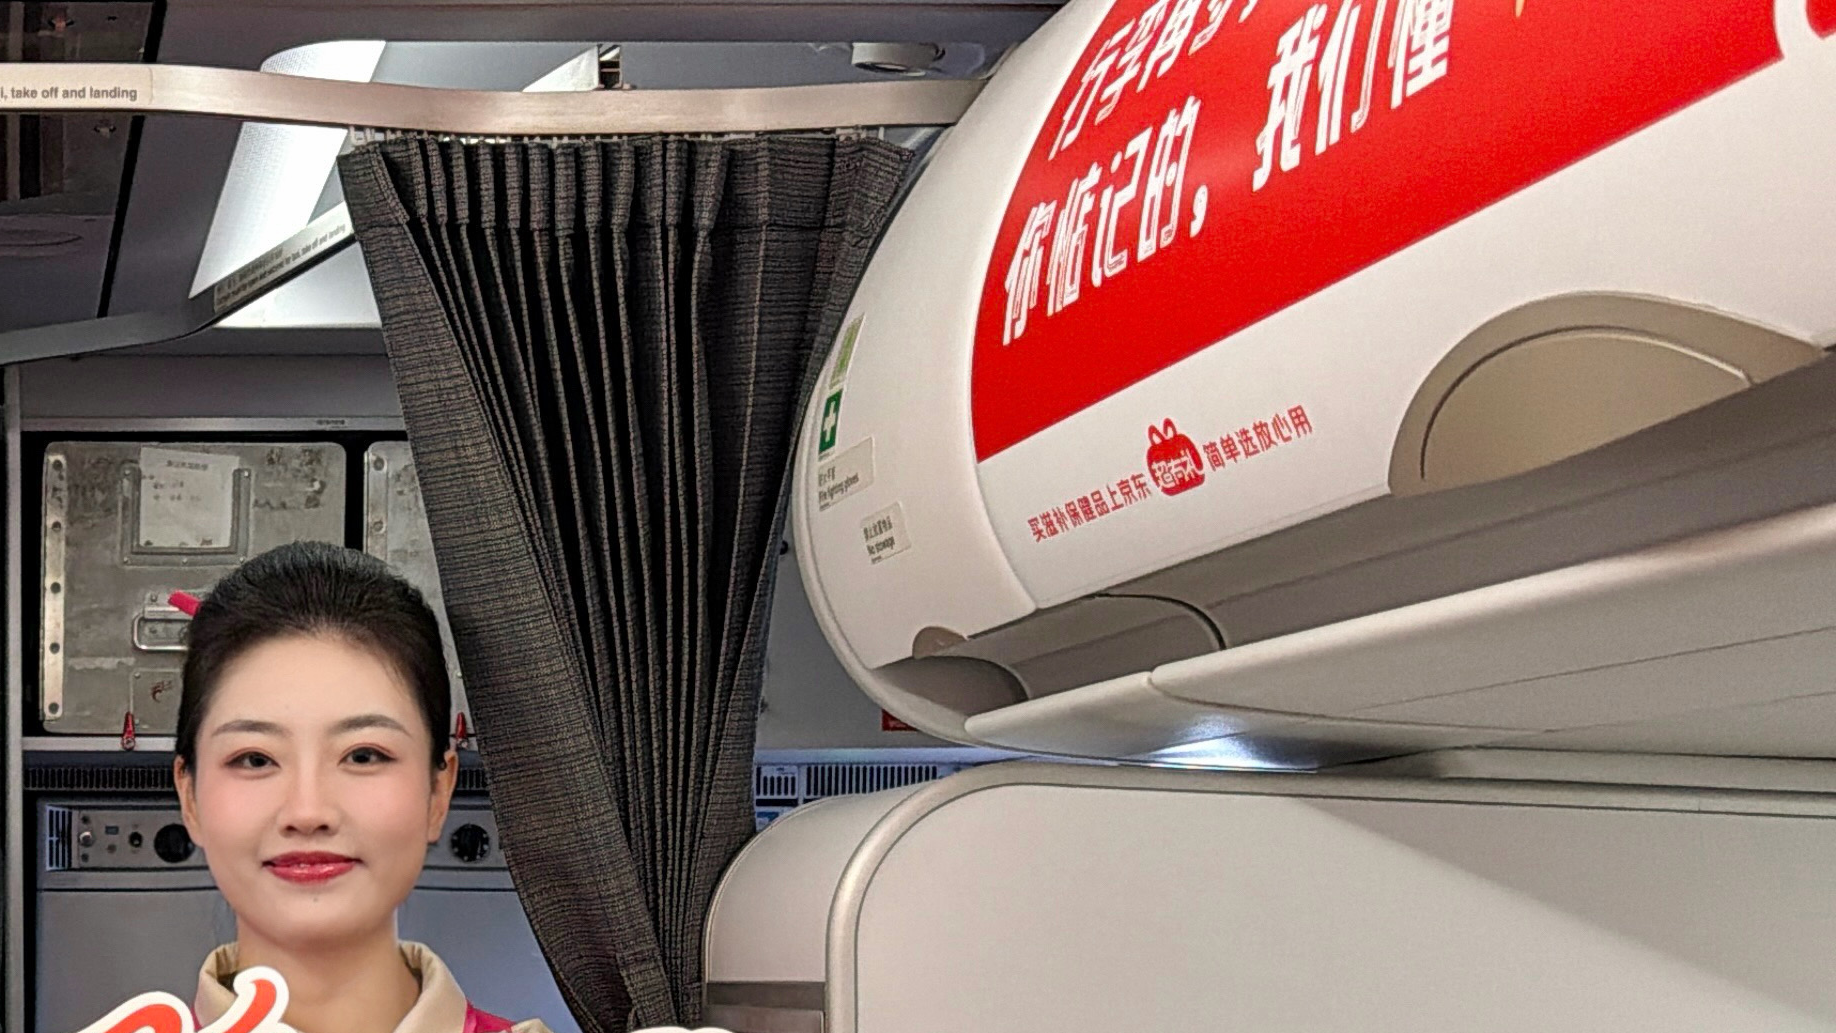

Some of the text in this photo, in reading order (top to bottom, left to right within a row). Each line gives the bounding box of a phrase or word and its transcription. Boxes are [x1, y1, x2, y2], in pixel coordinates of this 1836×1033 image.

[11, 86, 37, 99] take
[42, 86, 58, 99] off
[62, 86, 86, 99] and
[90, 86, 138, 102] landing
[1048, 0, 1257, 161] 行李再
[1028, 471, 1152, 543] 买滋补保健品上京东
[1202, 405, 1313, 472] 简单选放心用
